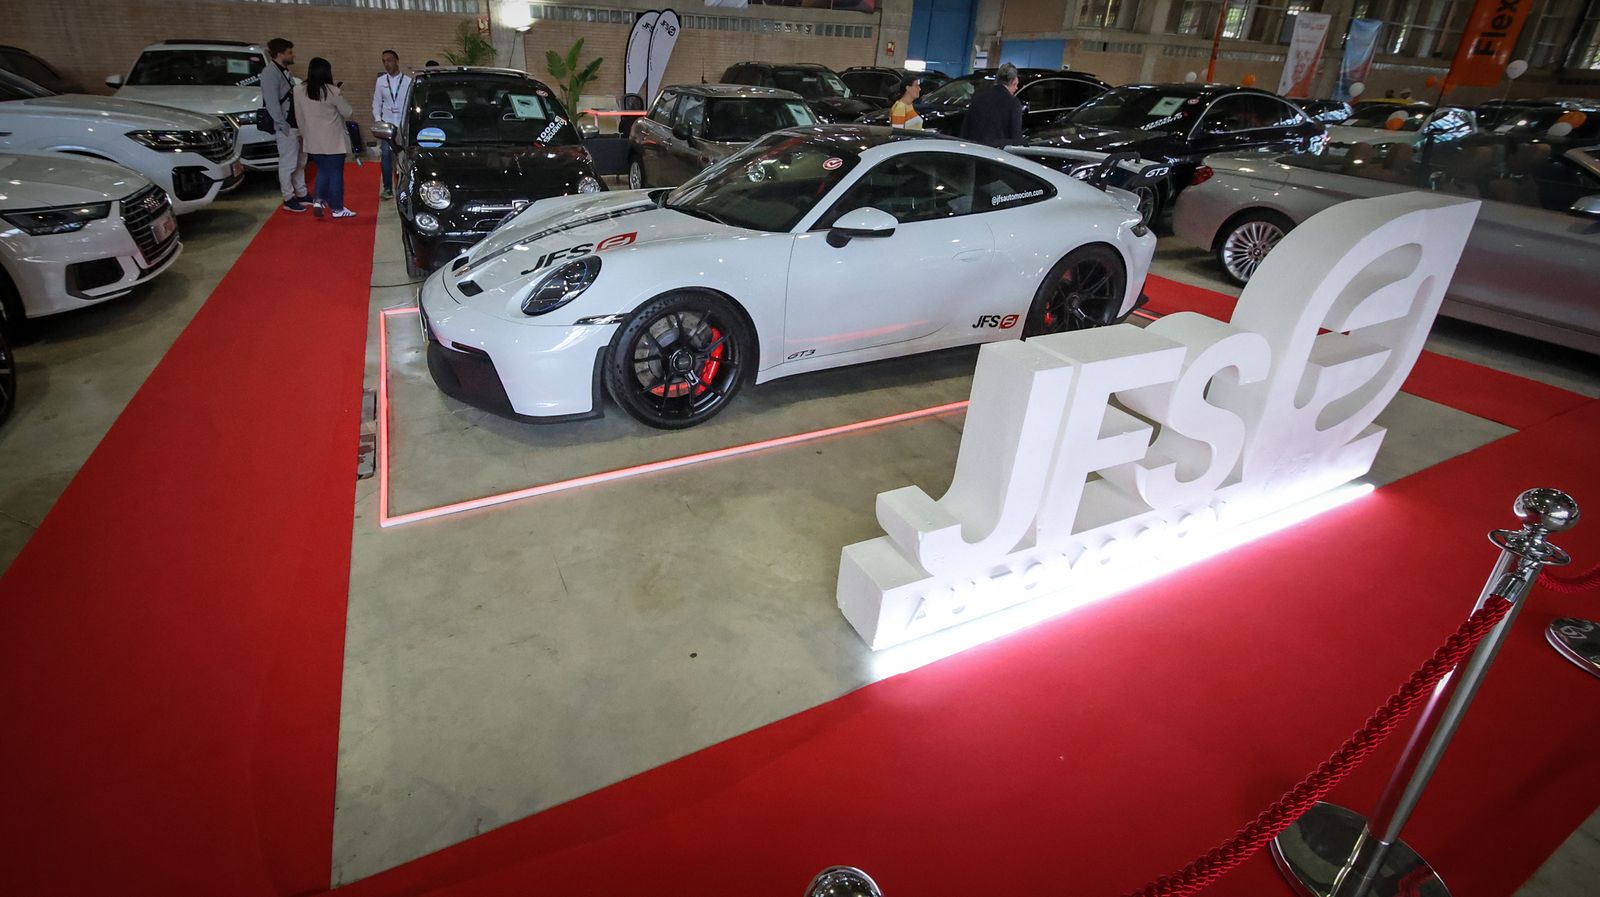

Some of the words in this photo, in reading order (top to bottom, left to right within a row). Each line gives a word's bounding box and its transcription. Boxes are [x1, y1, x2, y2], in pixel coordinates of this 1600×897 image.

[536, 121, 556, 142] 1000
[1145, 166, 1170, 178] GT3
[991, 189, 1044, 205] @jfsautomocion.com
[521, 243, 594, 275] JFS
[972, 315, 1001, 328] JFS
[787, 349, 817, 360] GT3
[876, 330, 1272, 580] JFS
